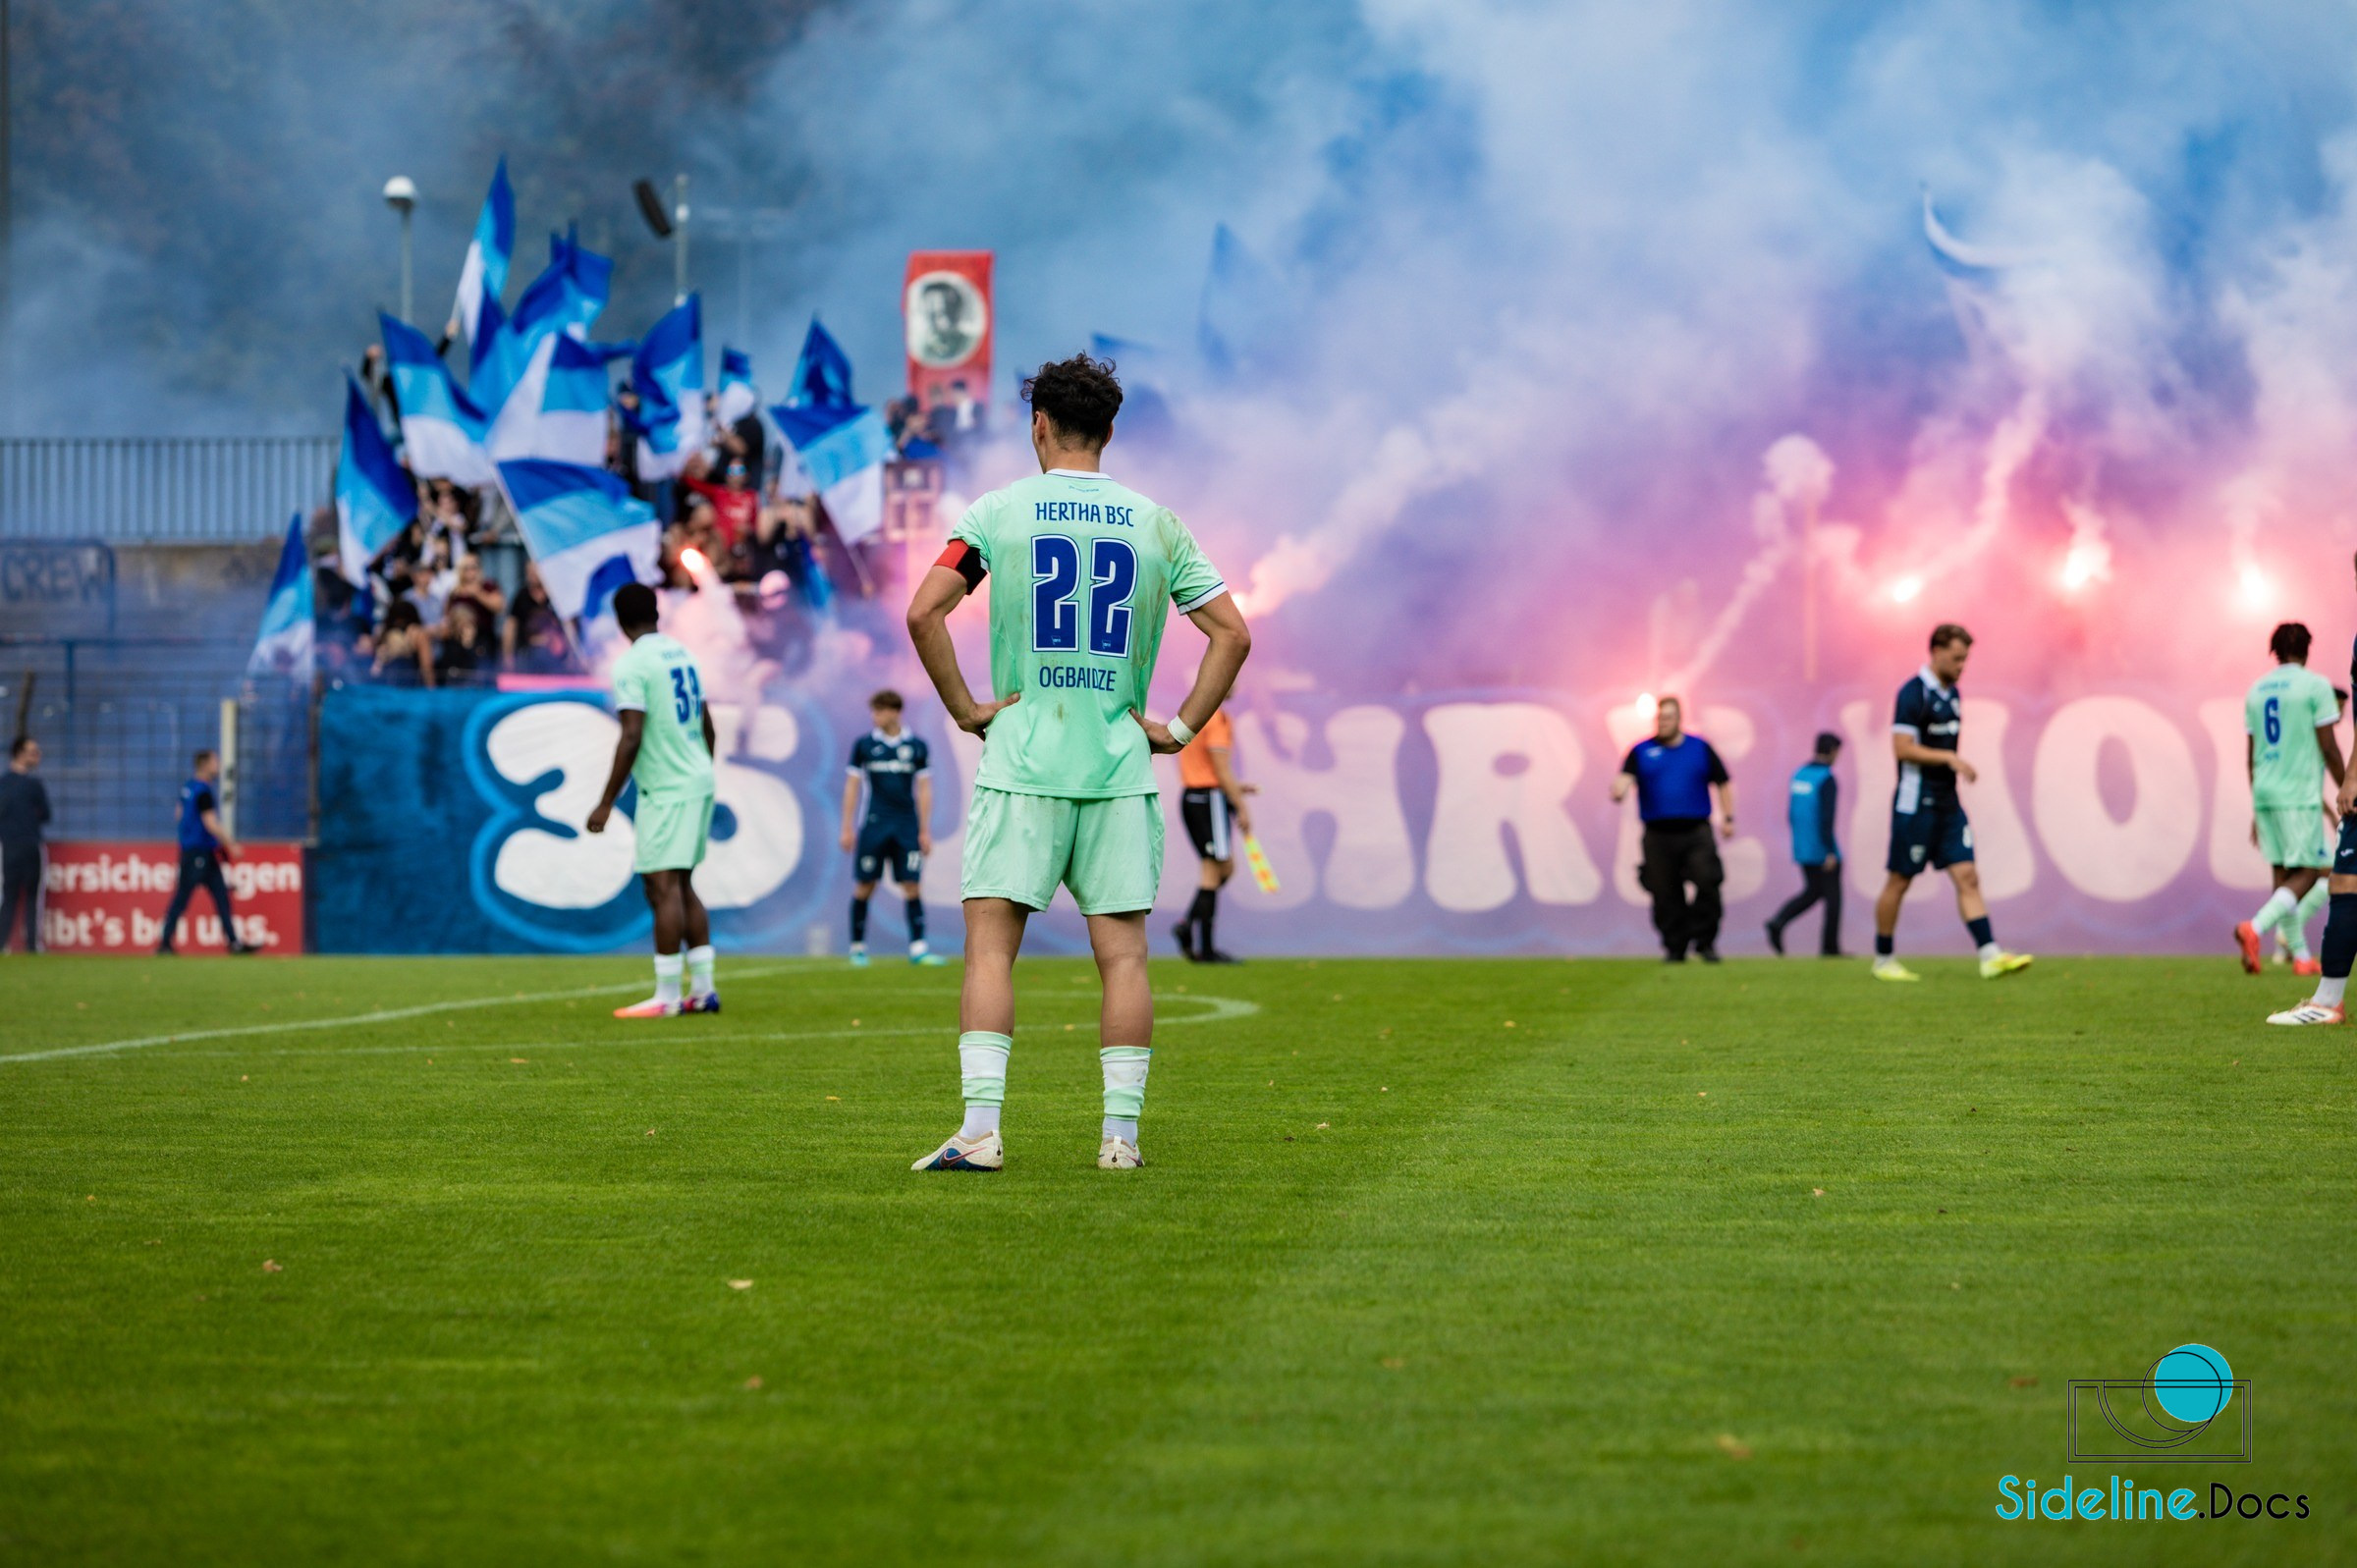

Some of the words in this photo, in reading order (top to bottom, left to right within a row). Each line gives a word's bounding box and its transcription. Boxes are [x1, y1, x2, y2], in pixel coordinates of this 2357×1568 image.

[1035, 502, 1101, 523] HERTHA
[1105, 505, 1134, 527] BSC
[1030, 533, 1139, 659] 22
[1039, 666, 1118, 691] OGBAIDZE
[2264, 696, 2281, 746] 6
[46, 852, 302, 900] ersichegen
[44, 907, 125, 946] ibt's
